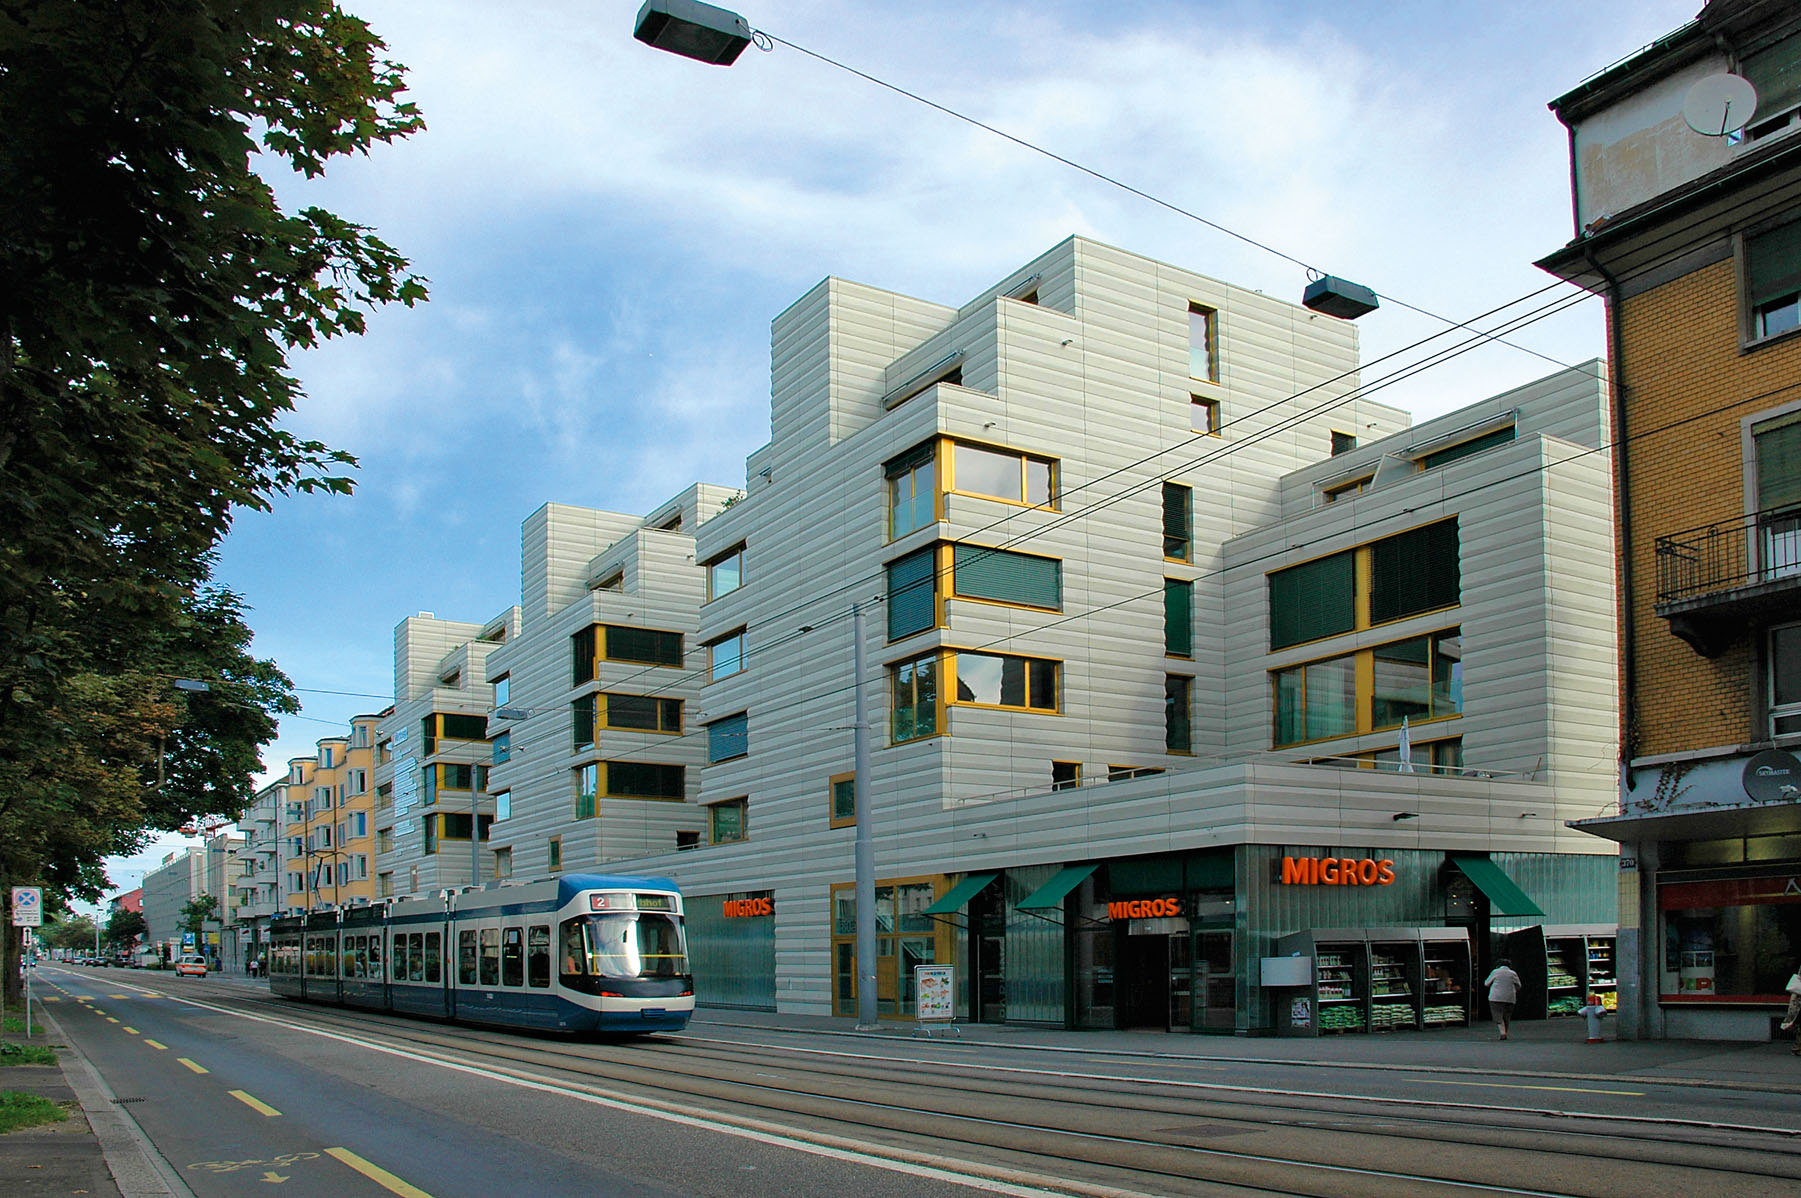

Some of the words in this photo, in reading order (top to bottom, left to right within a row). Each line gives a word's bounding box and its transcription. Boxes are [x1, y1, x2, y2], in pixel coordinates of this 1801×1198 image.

[1282, 856, 1396, 886] MIGROS
[596, 897, 606, 907] 2
[723, 897, 772, 918] MIGROS
[1107, 897, 1180, 920] MIGROS
